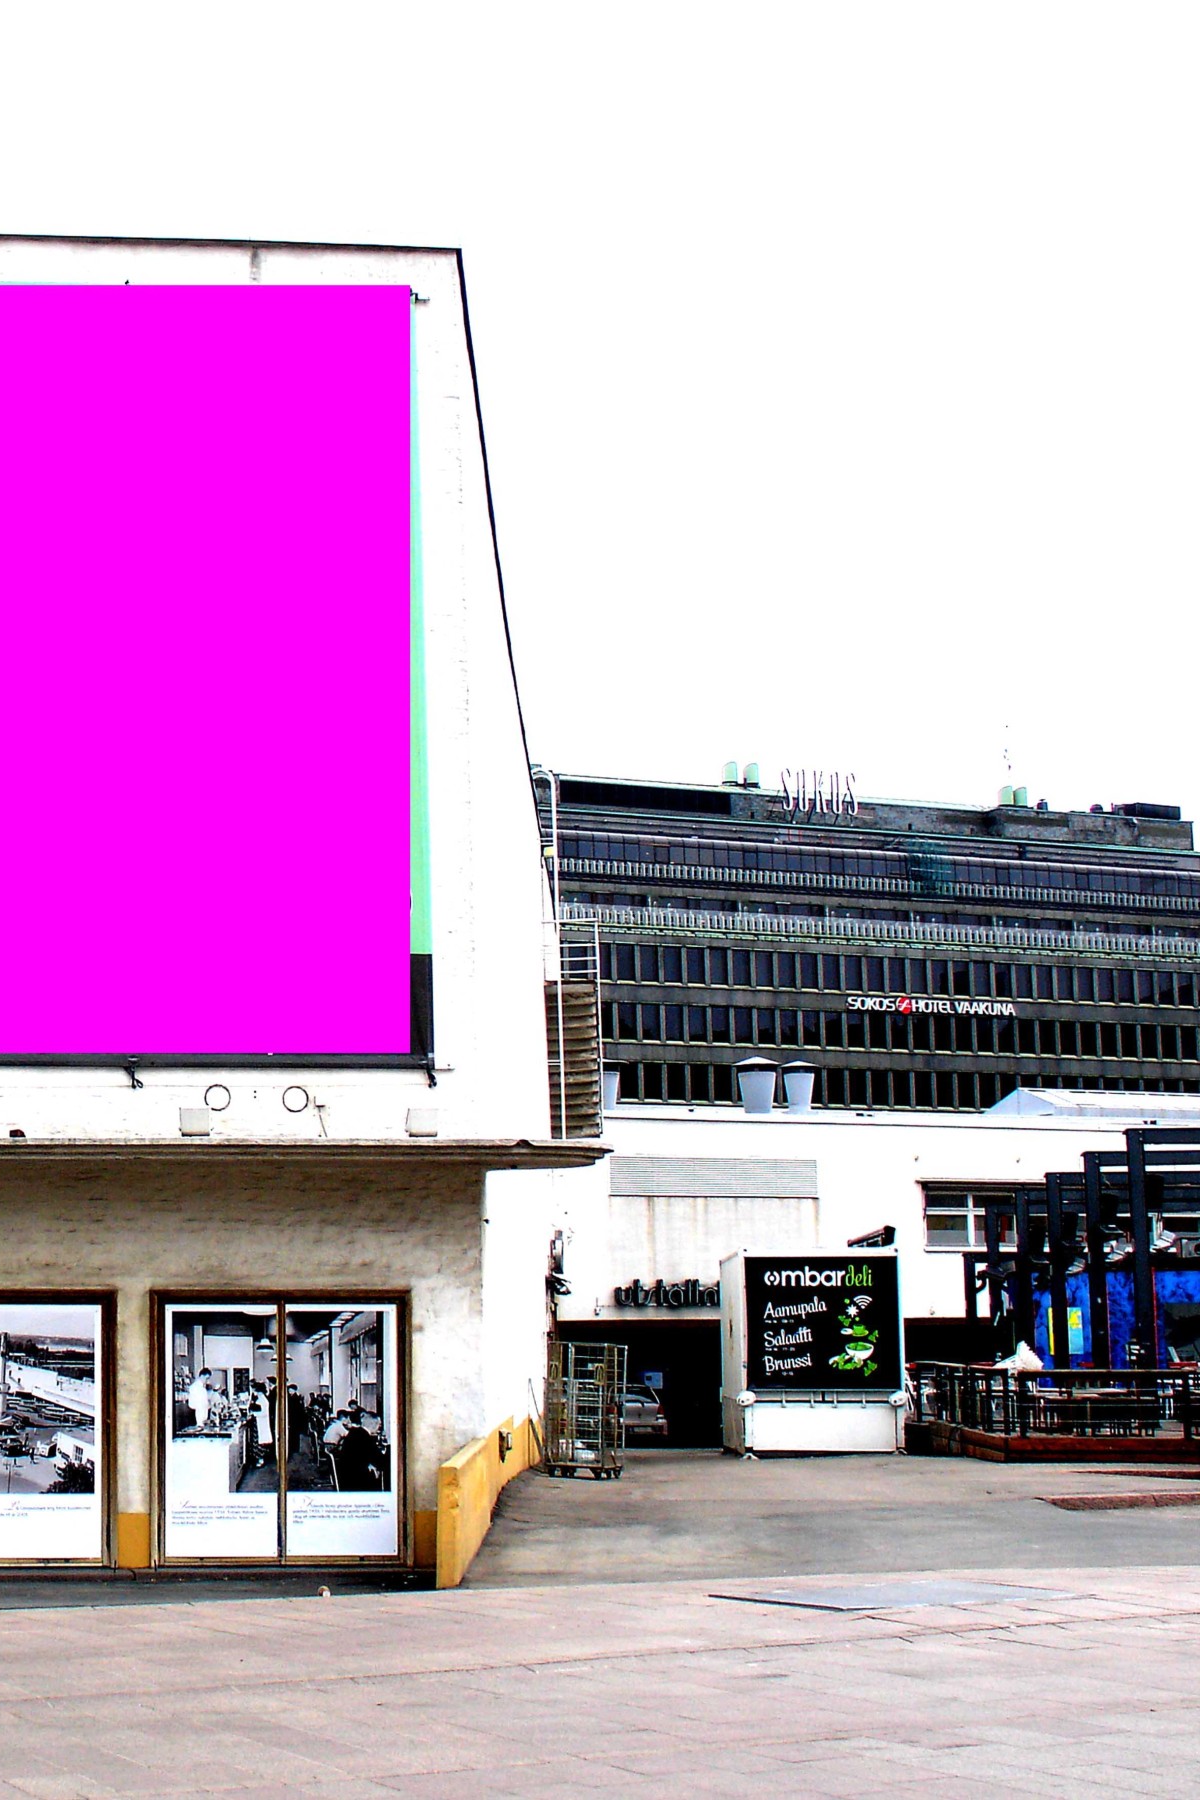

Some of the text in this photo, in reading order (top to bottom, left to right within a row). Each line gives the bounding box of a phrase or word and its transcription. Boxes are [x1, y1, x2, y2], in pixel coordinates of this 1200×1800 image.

[781, 768, 858, 815] SOKOS
[847, 996, 1017, 1017] SOKOS HOTEL VAAKUNA
[763, 1295, 828, 1320] Aamupala
[763, 1325, 813, 1348] Salaatti
[764, 1353, 813, 1373] Brunssi
